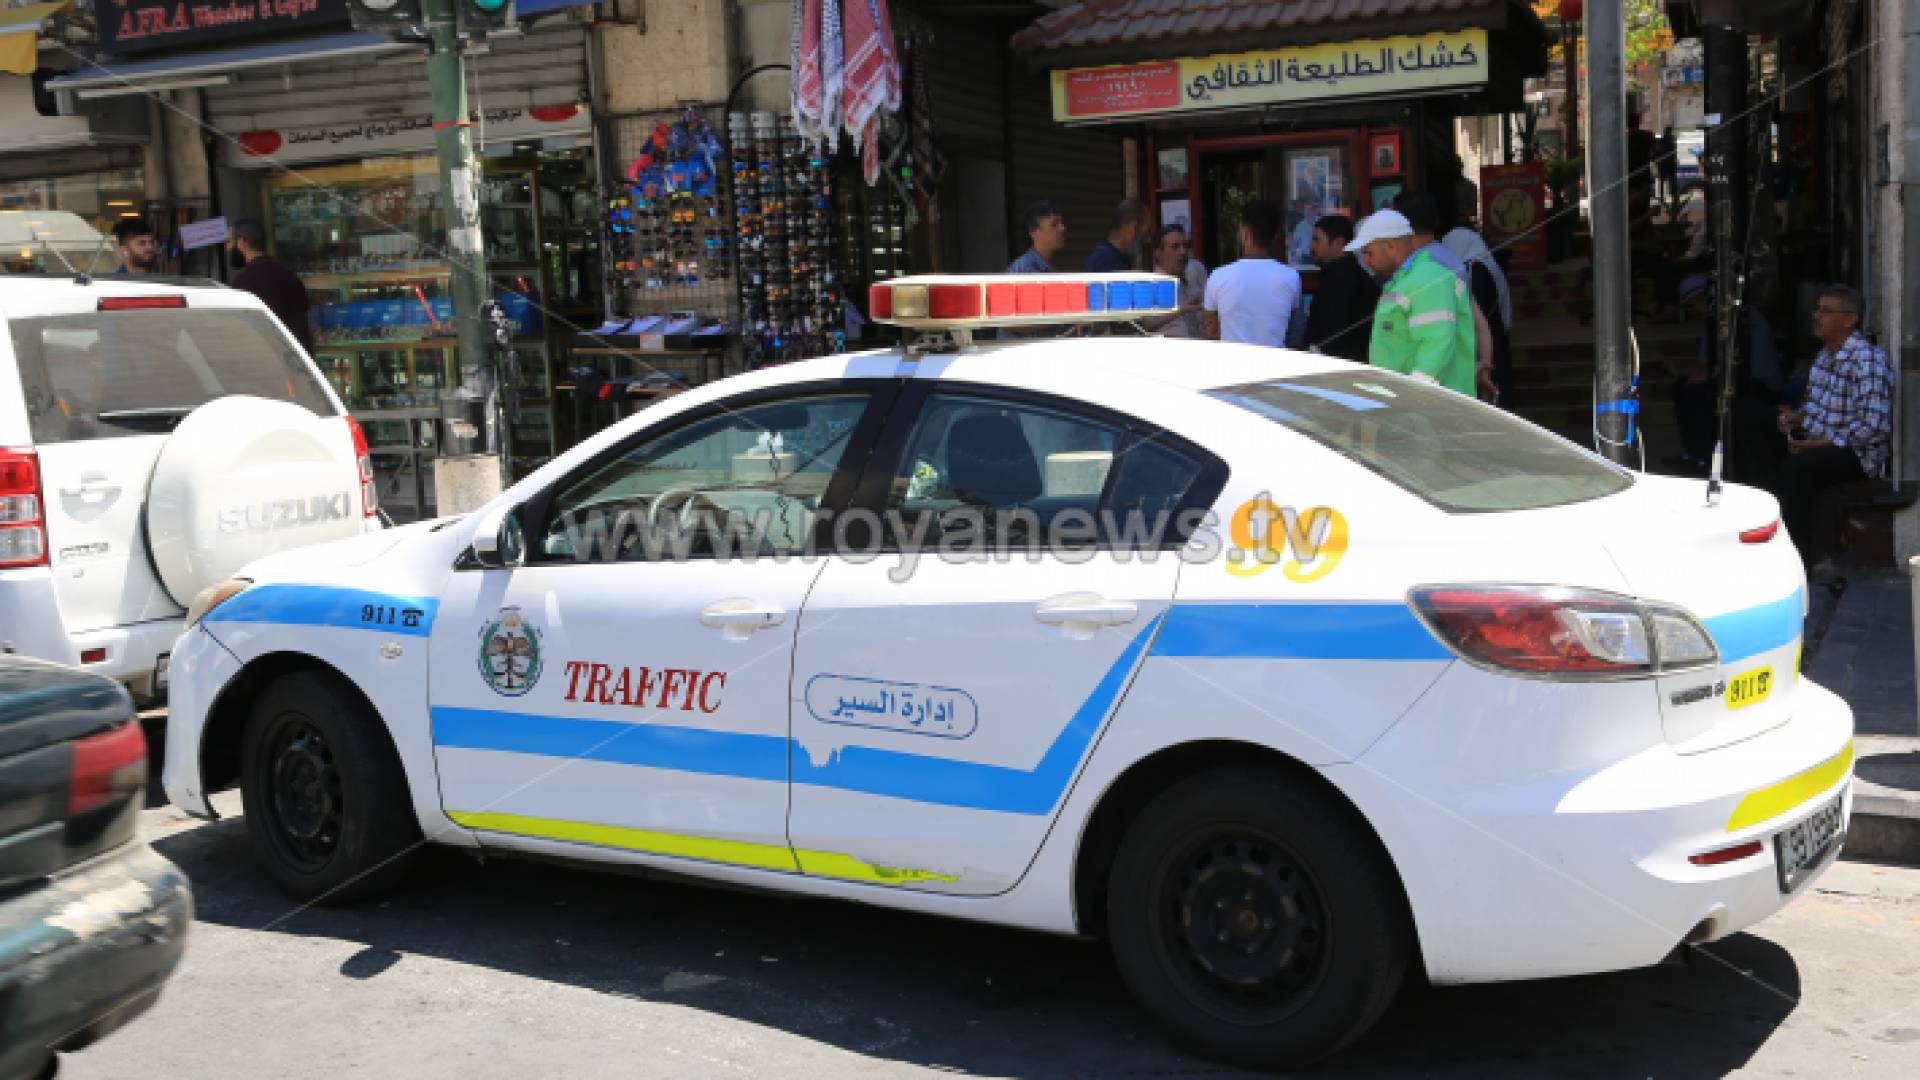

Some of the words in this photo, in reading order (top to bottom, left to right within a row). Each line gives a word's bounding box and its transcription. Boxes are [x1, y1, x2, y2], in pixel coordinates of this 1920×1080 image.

[116, 2, 190, 40] AFRA
[1287, 48, 1394, 85] الطليعة
[1398, 40, 1478, 71] كشك
[1185, 58, 1282, 100] الثقافي
[217, 490, 351, 534] SUZUKI
[1224, 498, 1349, 584] 99
[361, 603, 397, 625] 911
[563, 660, 728, 714] TRAFFIC
[829, 687, 895, 719] السير
[1730, 677, 1754, 703] 911
[901, 690, 954, 730] إدارة
